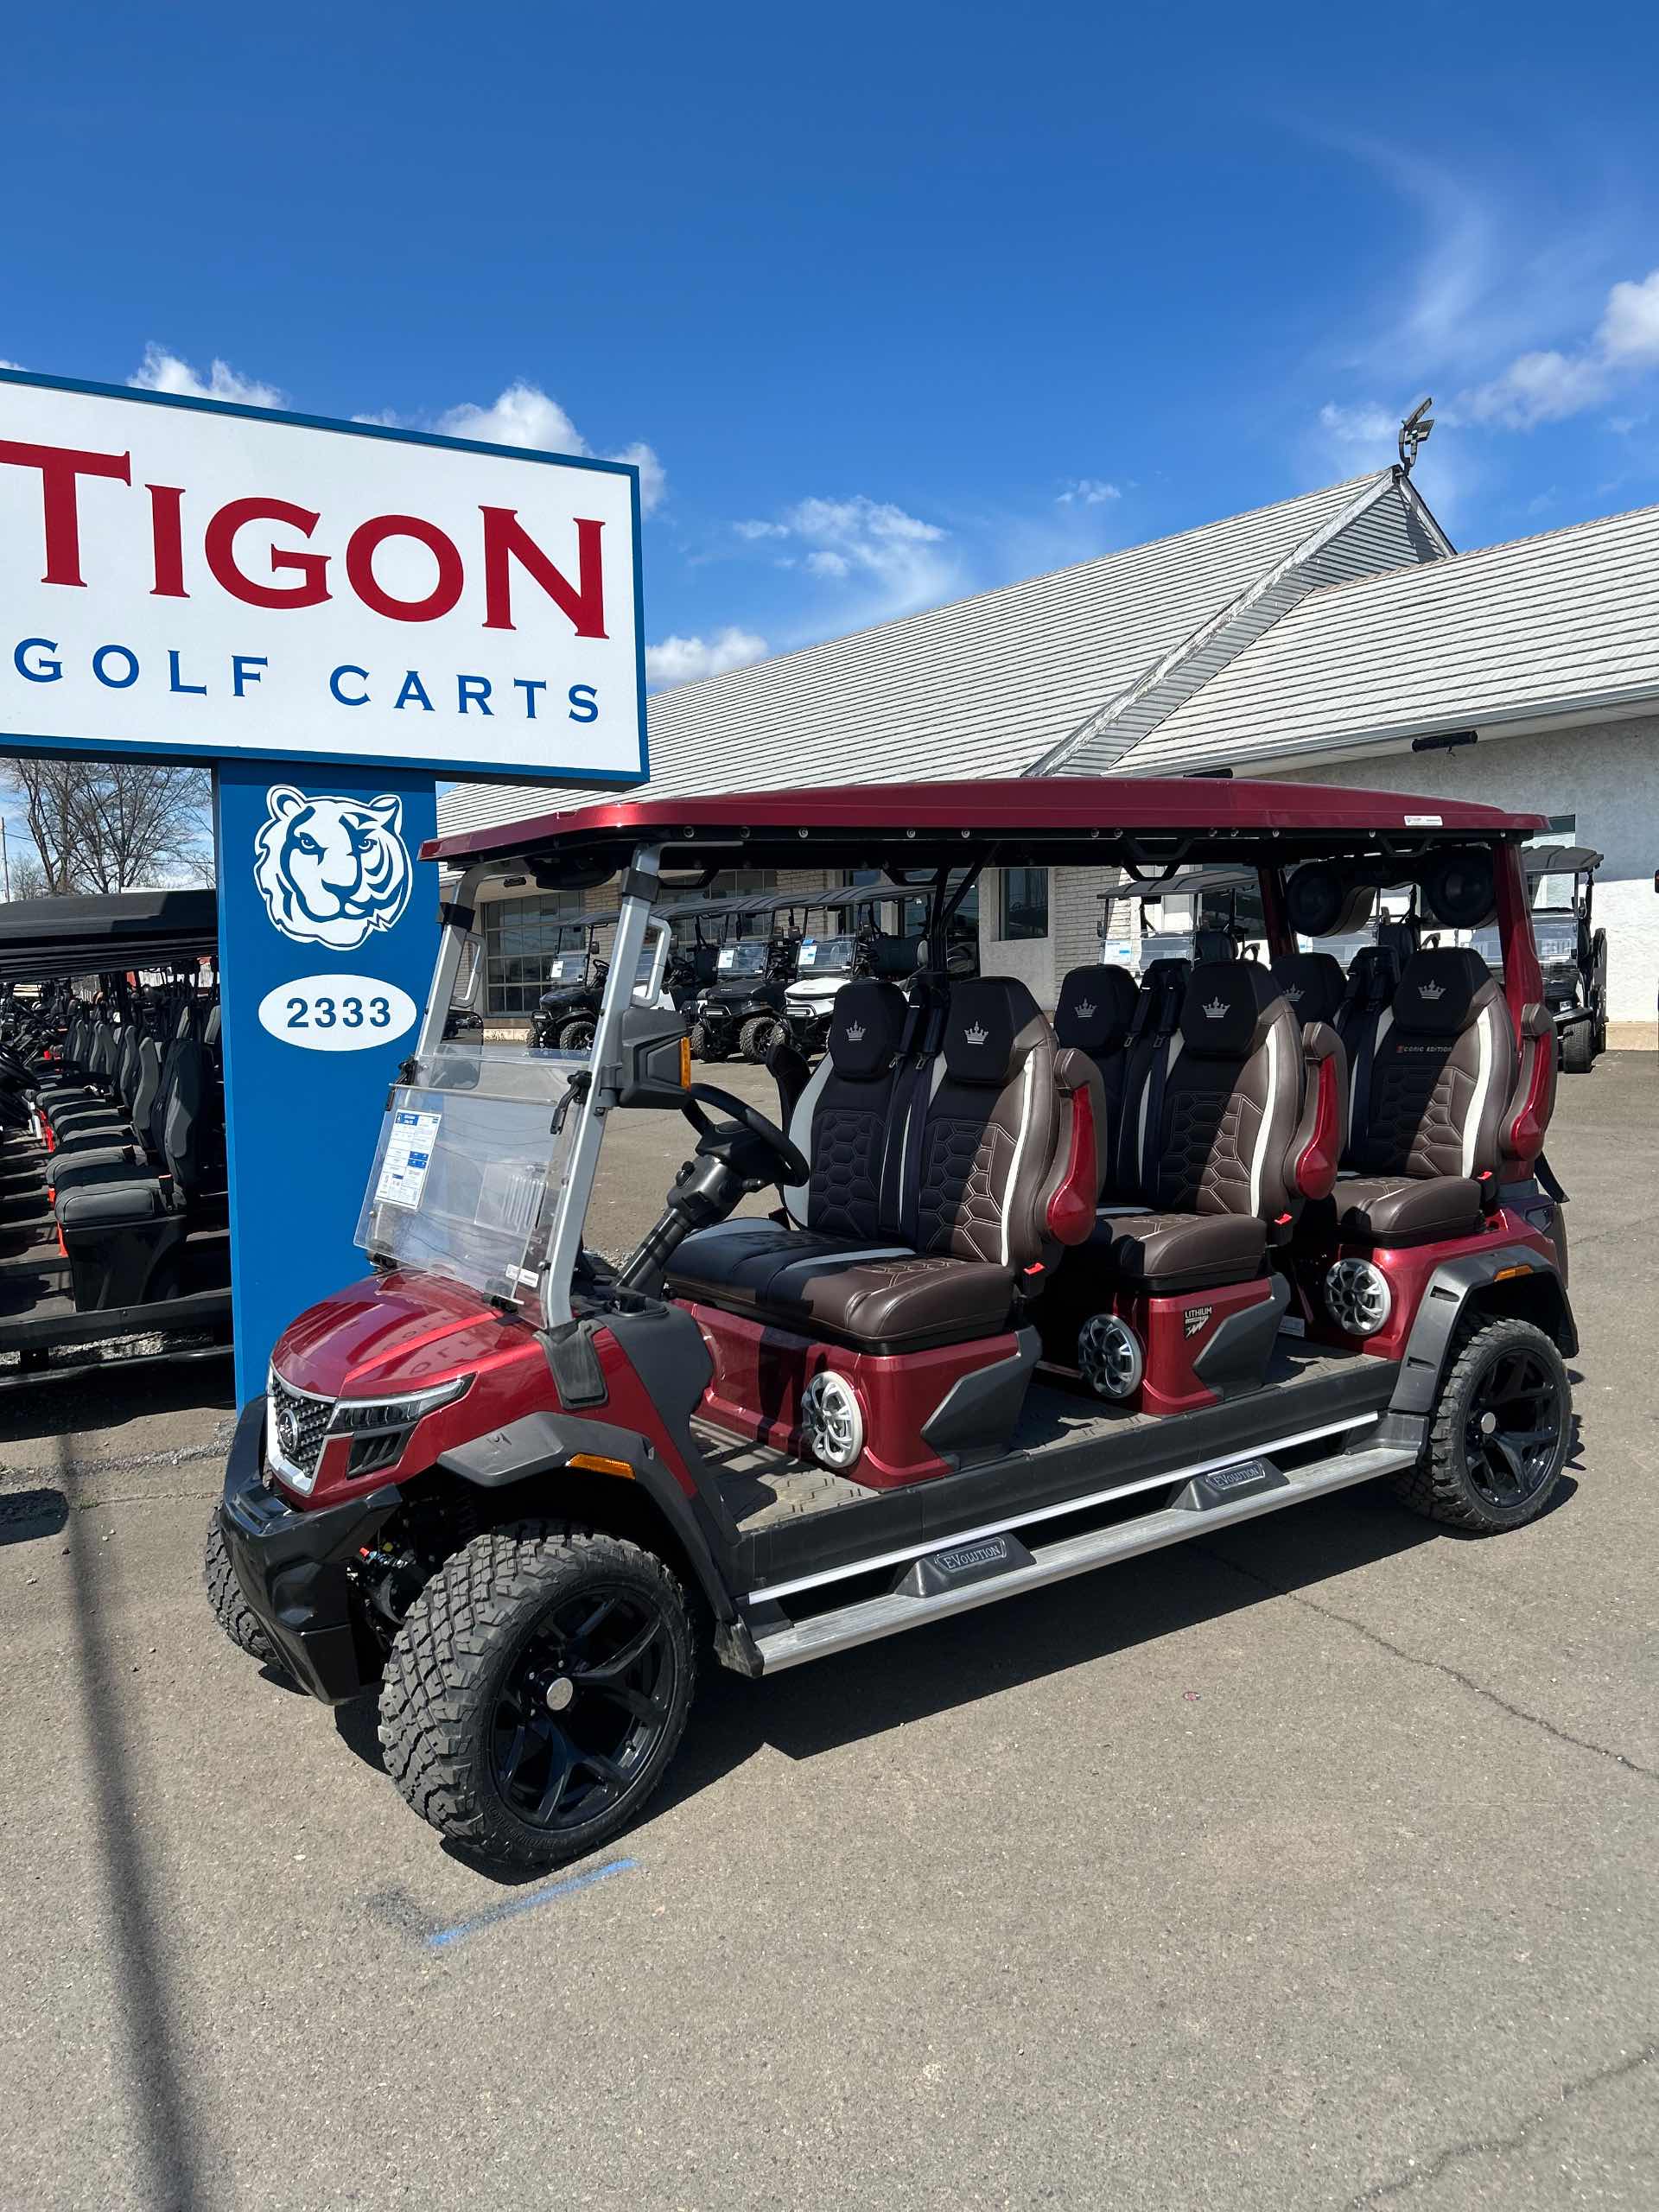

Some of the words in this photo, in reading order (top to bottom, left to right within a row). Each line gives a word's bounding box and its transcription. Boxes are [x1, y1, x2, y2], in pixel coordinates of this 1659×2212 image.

[0, 441, 610, 639] TIGON
[14, 638, 269, 697] GOLF
[330, 664, 600, 723] CARTS
[286, 996, 391, 1028] 2333
[1185, 1306, 1212, 1319] LITHIUM
